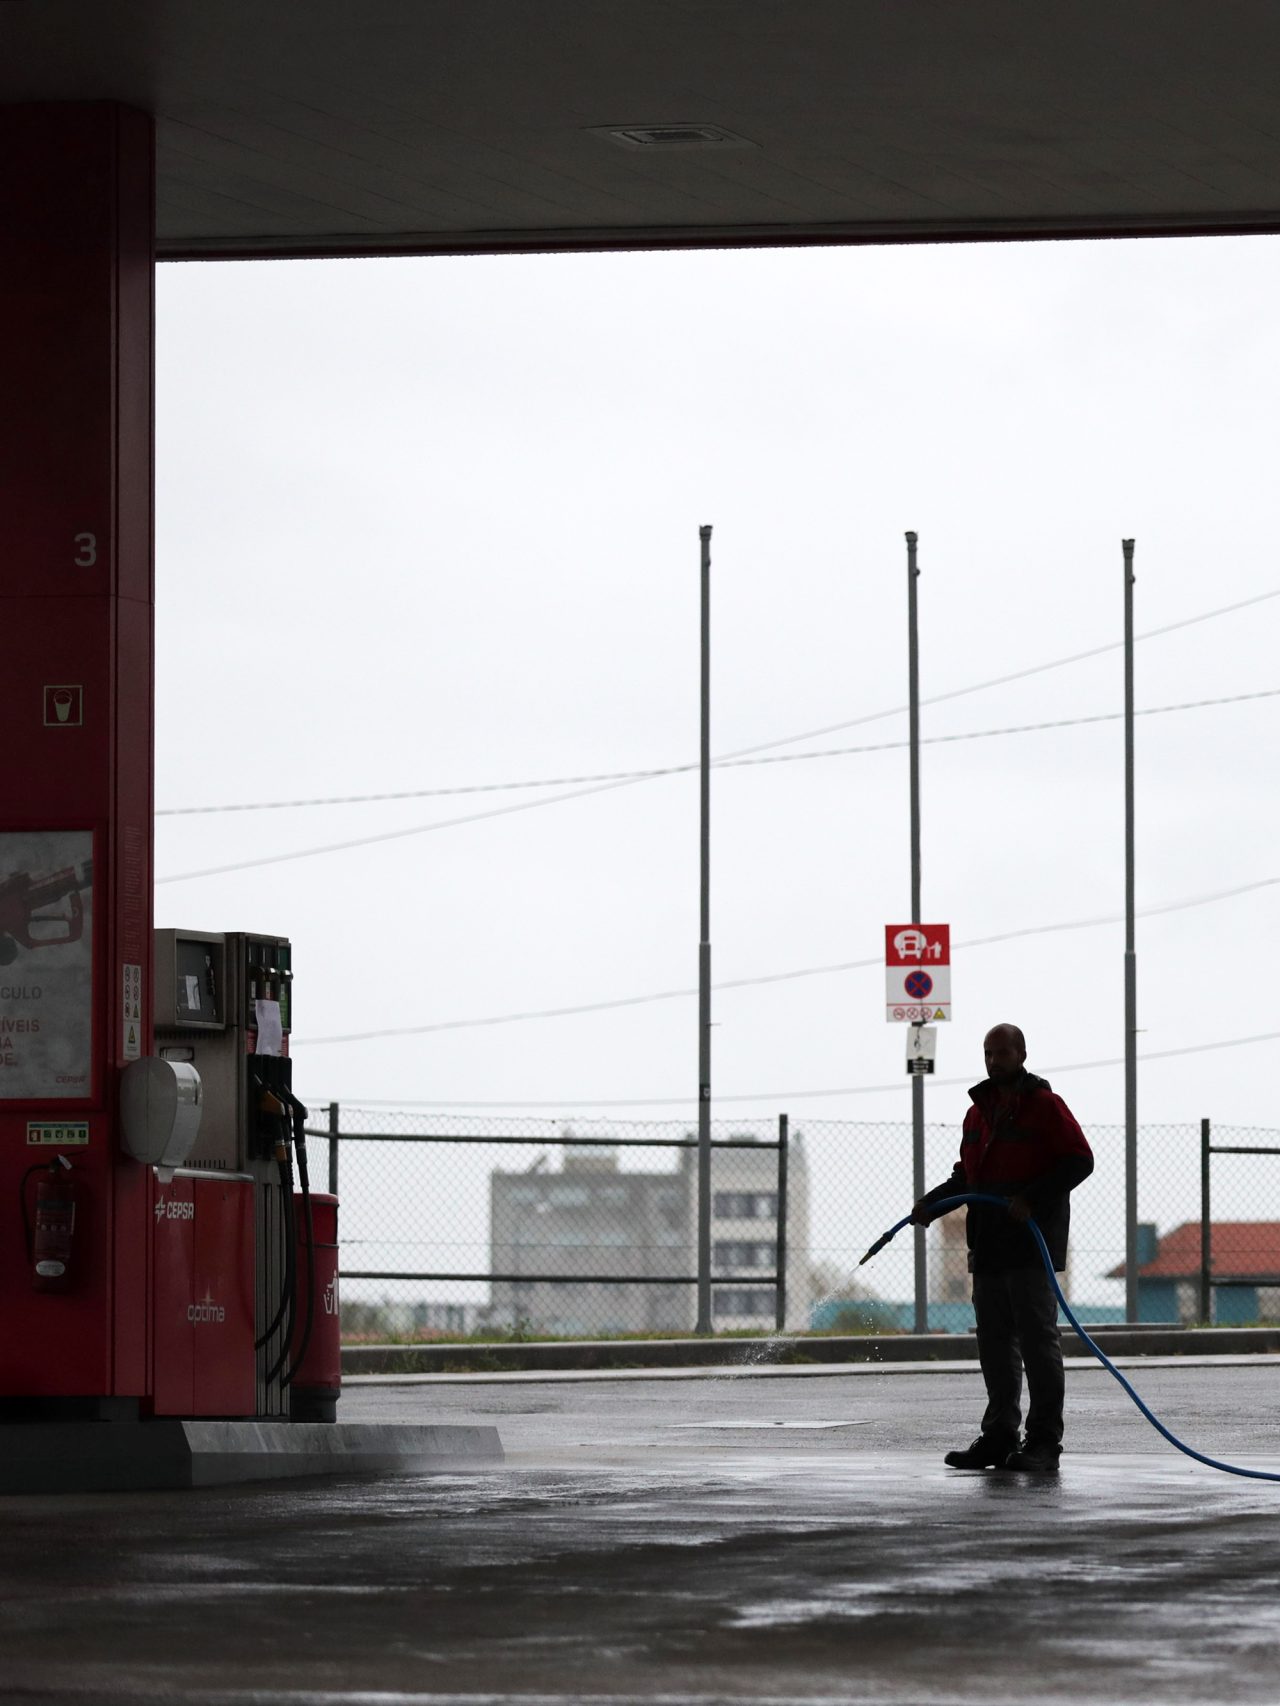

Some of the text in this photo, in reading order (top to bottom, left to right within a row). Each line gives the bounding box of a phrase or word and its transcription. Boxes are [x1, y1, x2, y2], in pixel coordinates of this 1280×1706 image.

[74, 532, 97, 566] 3
[166, 1201, 195, 1220] CEPSA
[187, 1303, 225, 1329] optima
